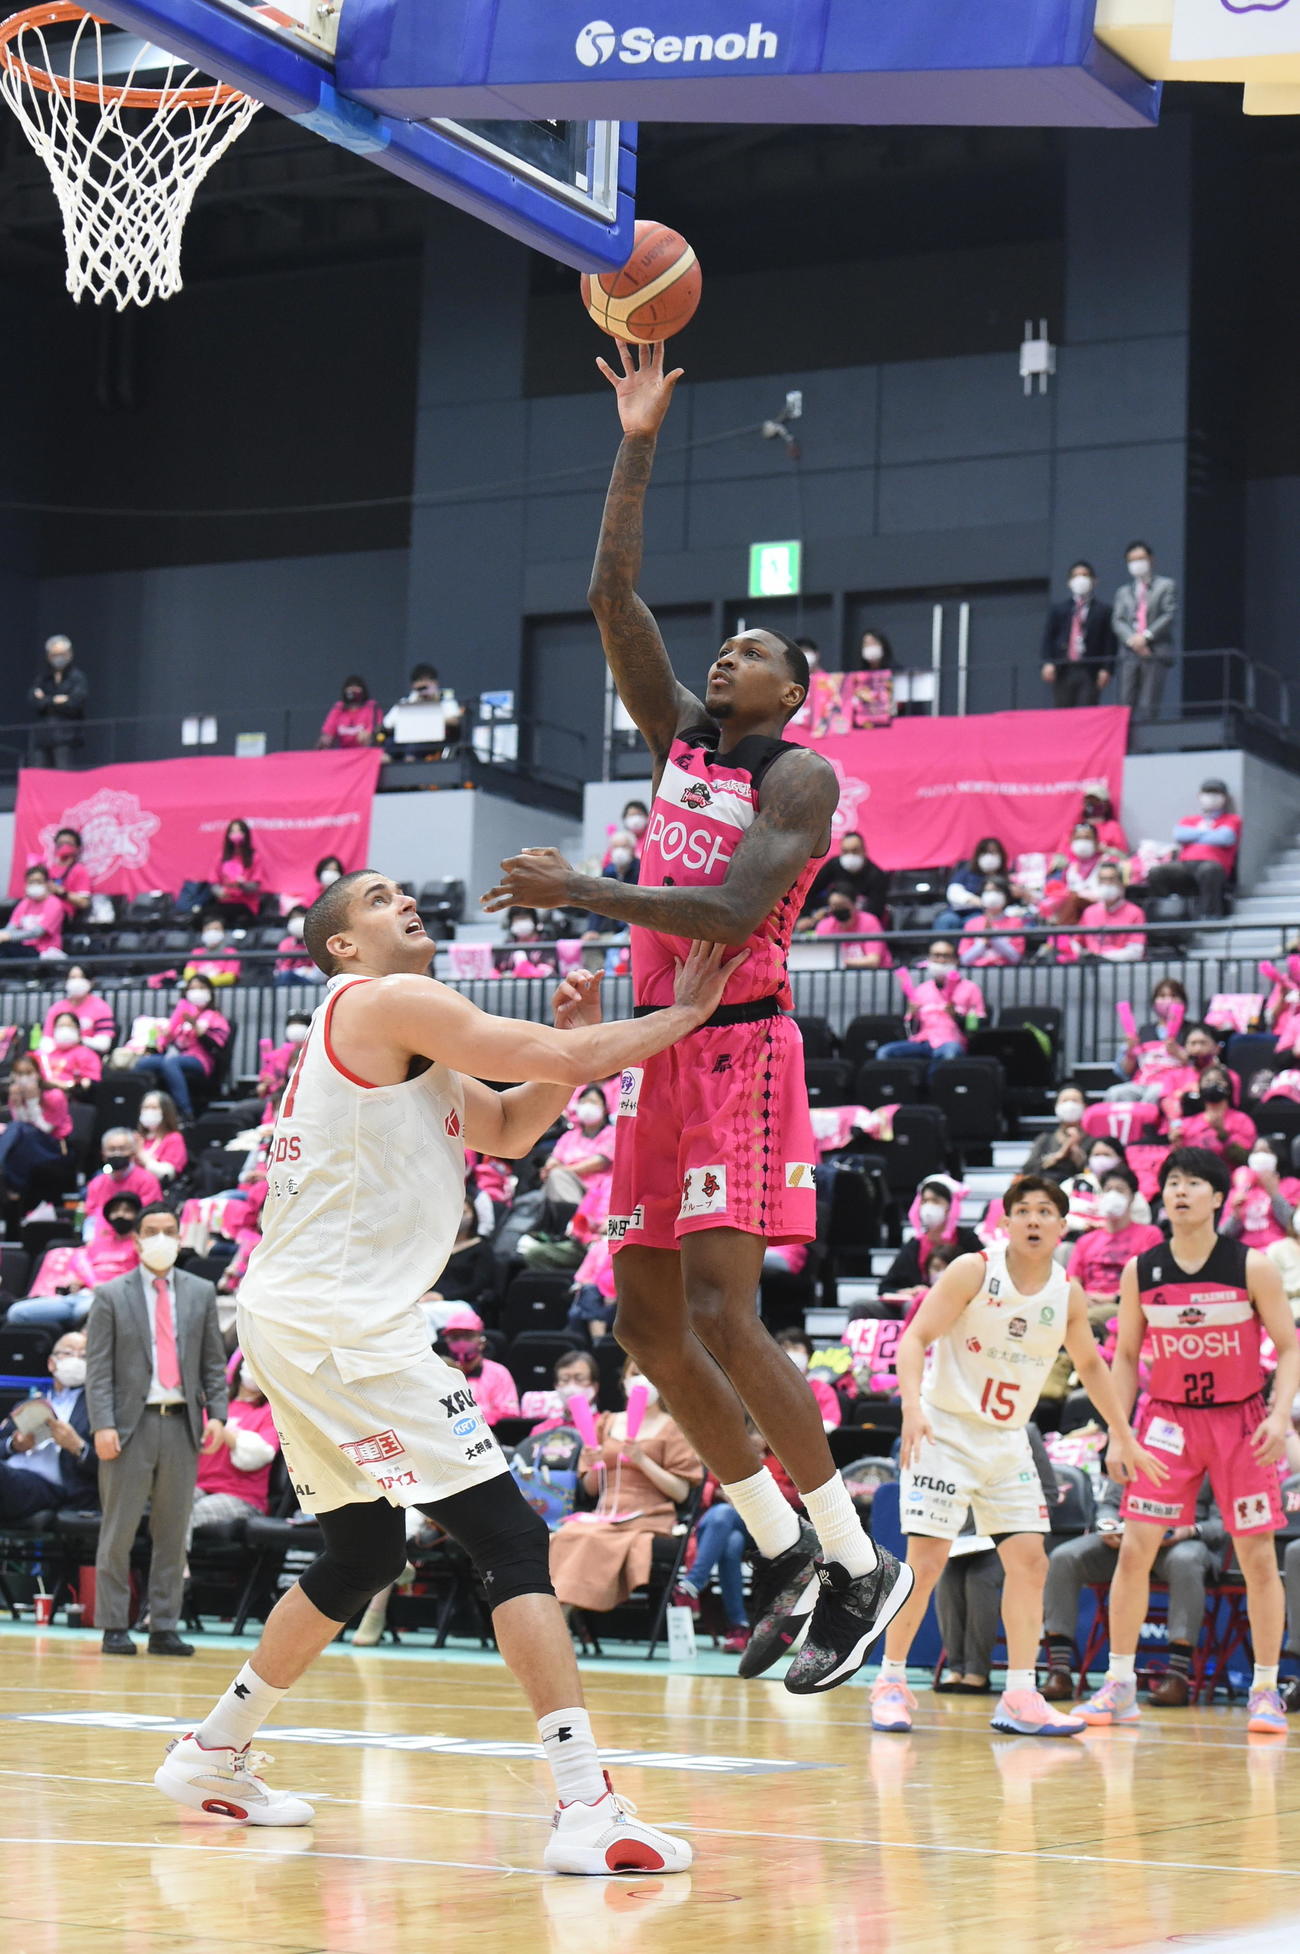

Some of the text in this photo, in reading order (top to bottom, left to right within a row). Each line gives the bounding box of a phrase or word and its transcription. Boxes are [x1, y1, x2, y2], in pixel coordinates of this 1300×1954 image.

[618, 22, 778, 64] Senoh
[980, 1377, 1021, 1421] 15
[1184, 1371, 1215, 1404] 22
